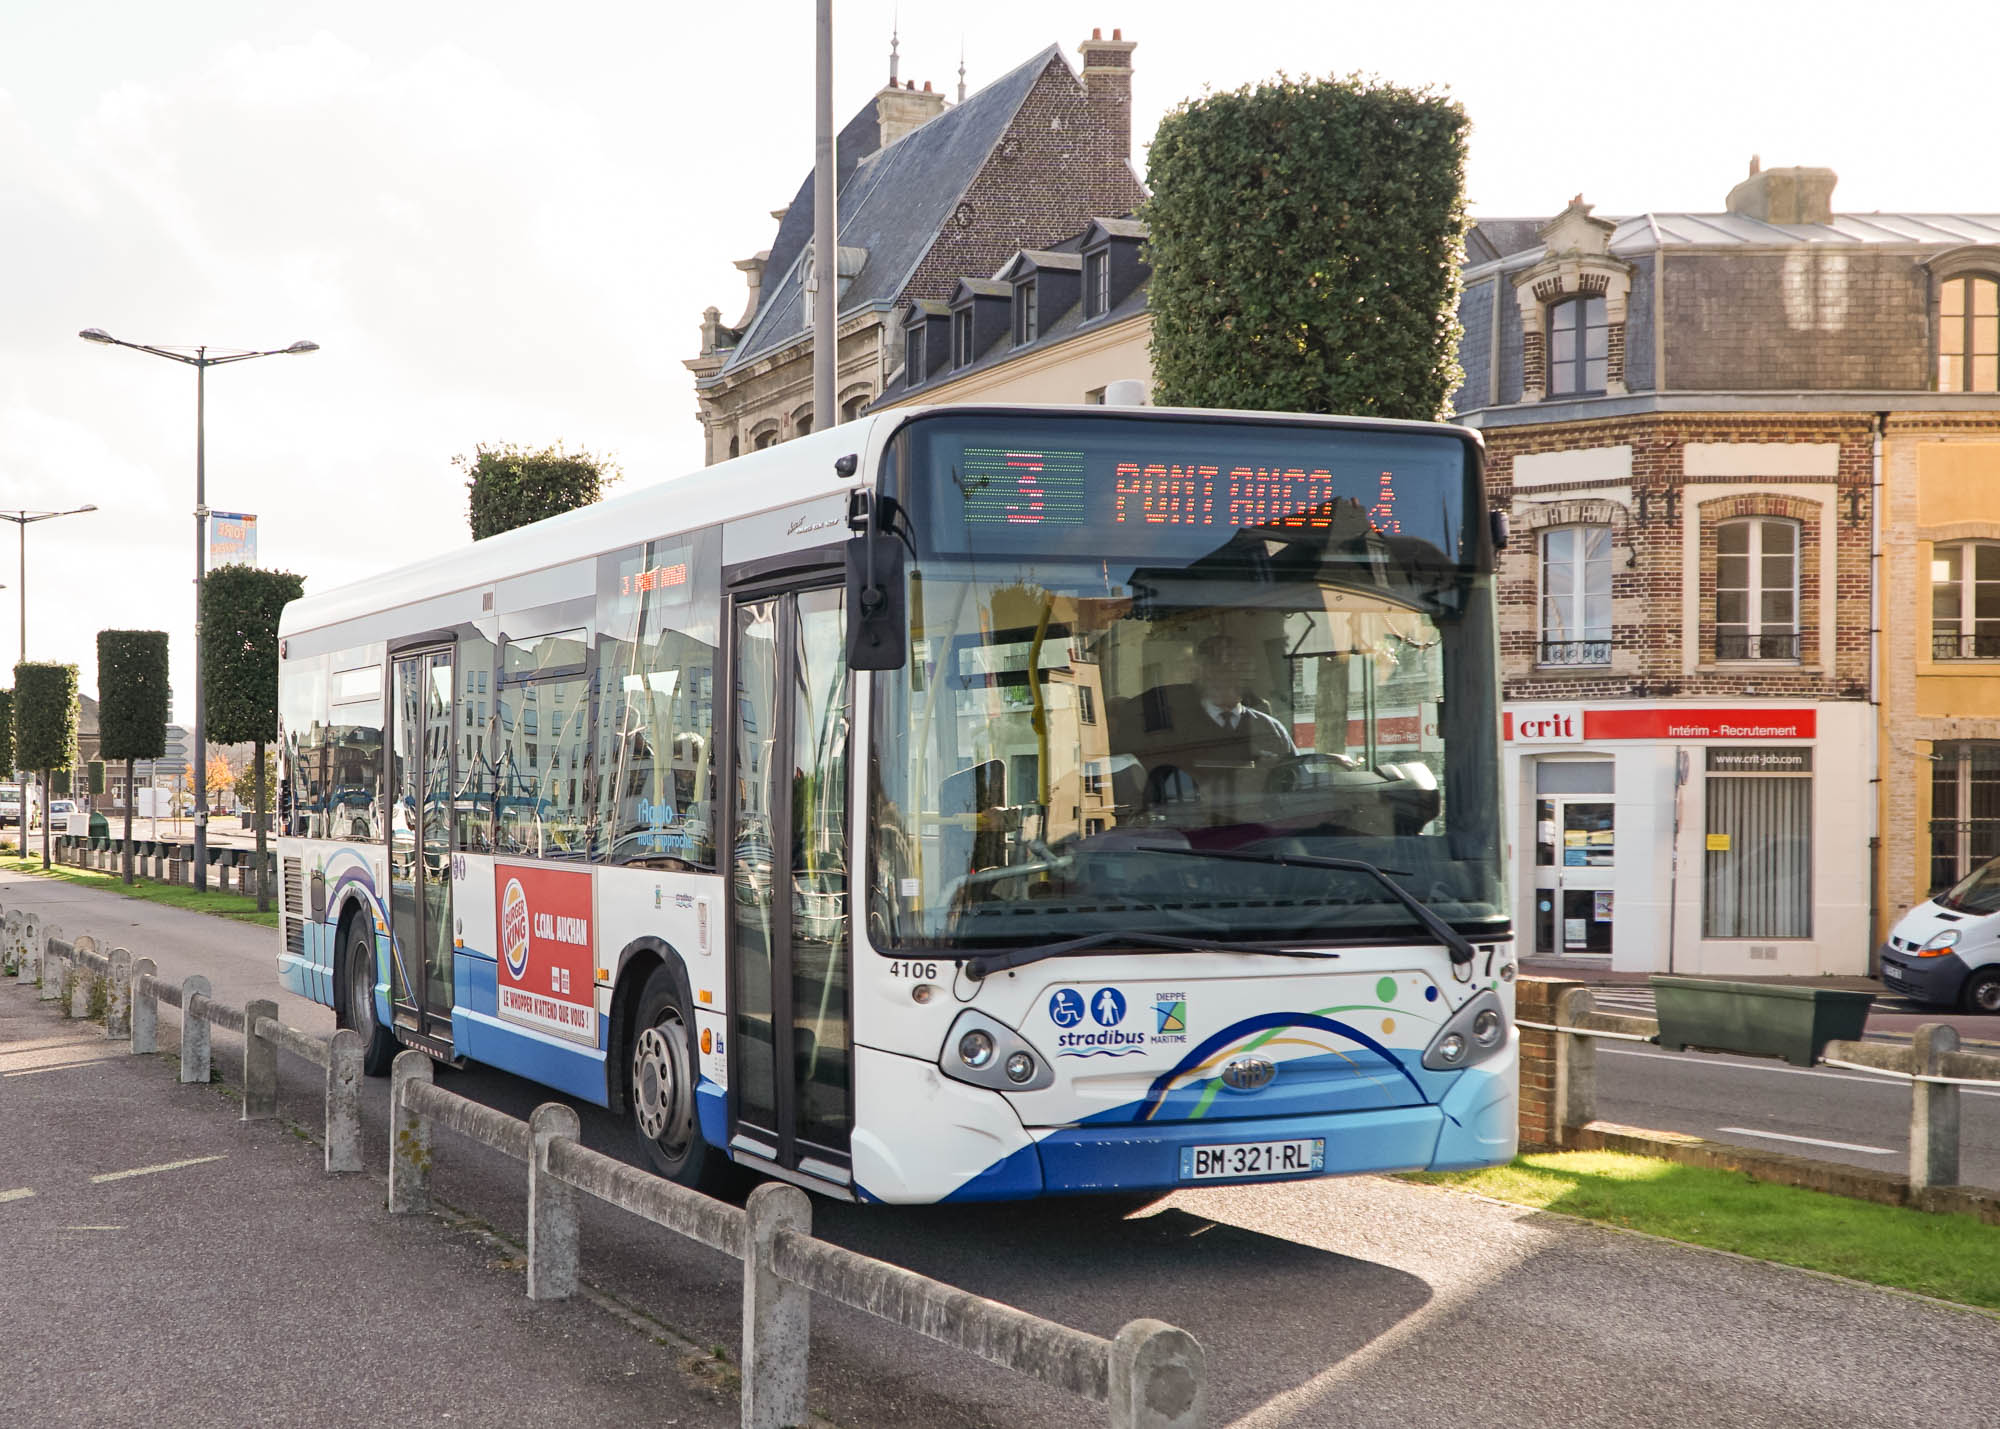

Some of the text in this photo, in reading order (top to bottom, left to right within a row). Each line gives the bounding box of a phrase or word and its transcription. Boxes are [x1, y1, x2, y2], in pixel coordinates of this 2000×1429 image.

[1004, 453, 1044, 523] 3
[1116, 463, 1332, 527] PONT ANGO
[1520, 713, 1575, 738] crit
[1669, 725, 1709, 736] Intérim
[1720, 725, 1797, 737] Recrutement
[1716, 754, 1802, 766] www.crit-job.com
[505, 900, 525, 931] BURGER
[506, 915, 526, 955] KING
[556, 915, 588, 946] AUCHAN
[890, 961, 937, 979] 4106
[1478, 945, 1495, 977] 7
[503, 990, 509, 1007] LE
[510, 991, 533, 1014] WHOPPER
[534, 999, 558, 1020] N'ATTEND
[559, 1005, 569, 1024] QUE
[571, 1007, 585, 1028] VOUS
[1156, 992, 1187, 1001] DIEPPE
[1058, 1030, 1145, 1047] stradibus
[1151, 1034, 1187, 1044] MARITIME
[1196, 1144, 1310, 1175] BM-321-RL
[1312, 1155, 1324, 1169] 76
